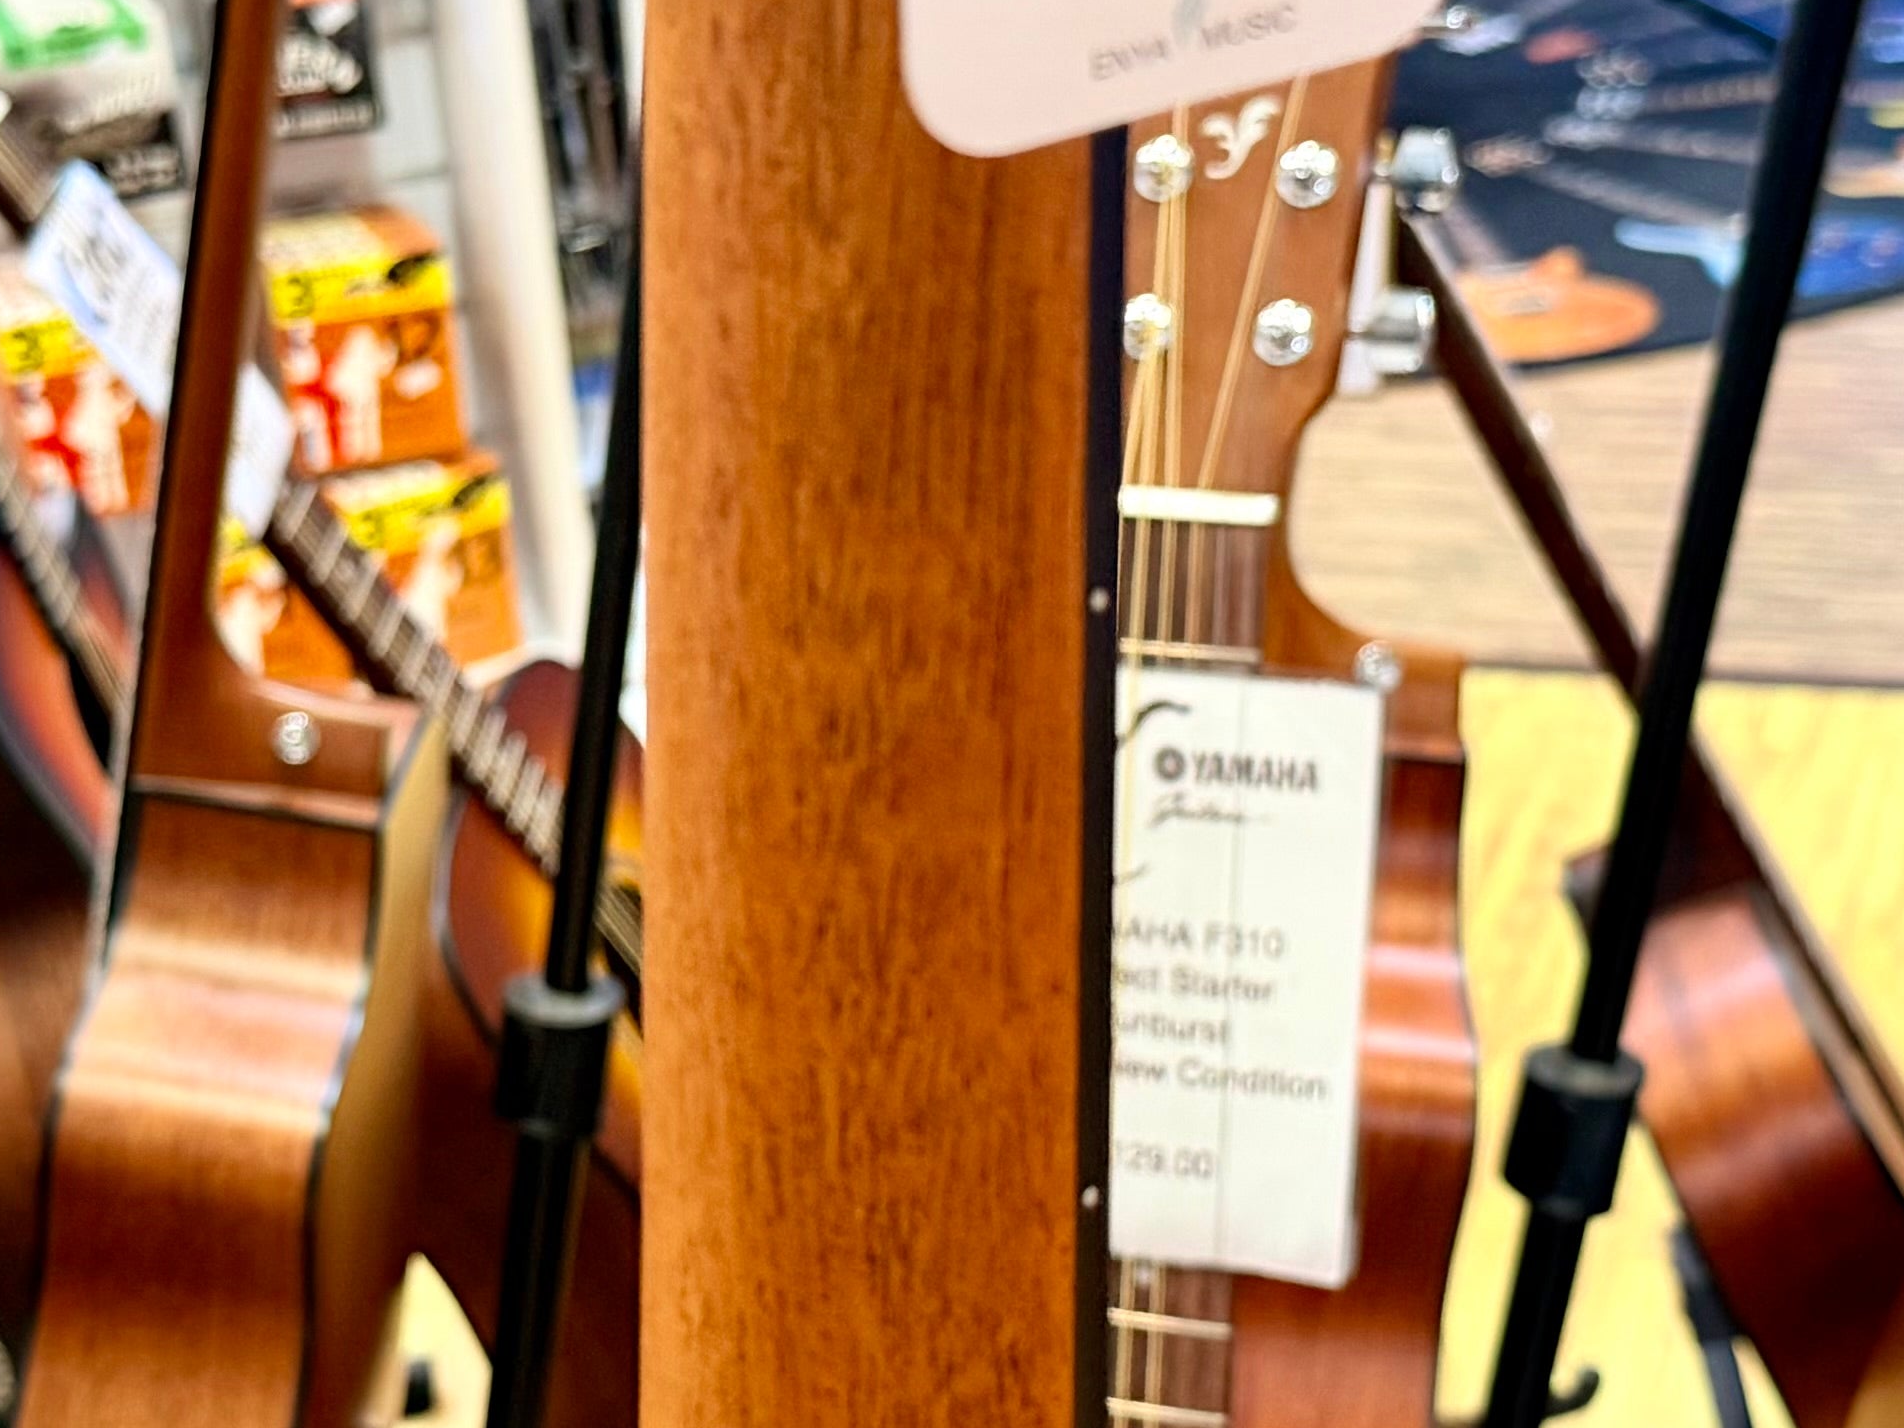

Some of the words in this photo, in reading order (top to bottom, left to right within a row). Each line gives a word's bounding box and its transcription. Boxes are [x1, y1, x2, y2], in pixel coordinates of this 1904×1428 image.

[1201, 2, 1297, 51] MUSIC
[1191, 750, 1319, 792] YAMAHA
[1114, 917, 1193, 949] AHA
[1203, 921, 1286, 963] F310
[1169, 963, 1276, 1004] Starter
[1114, 1012, 1231, 1045] unburst
[1176, 1056, 1329, 1100] Condition
